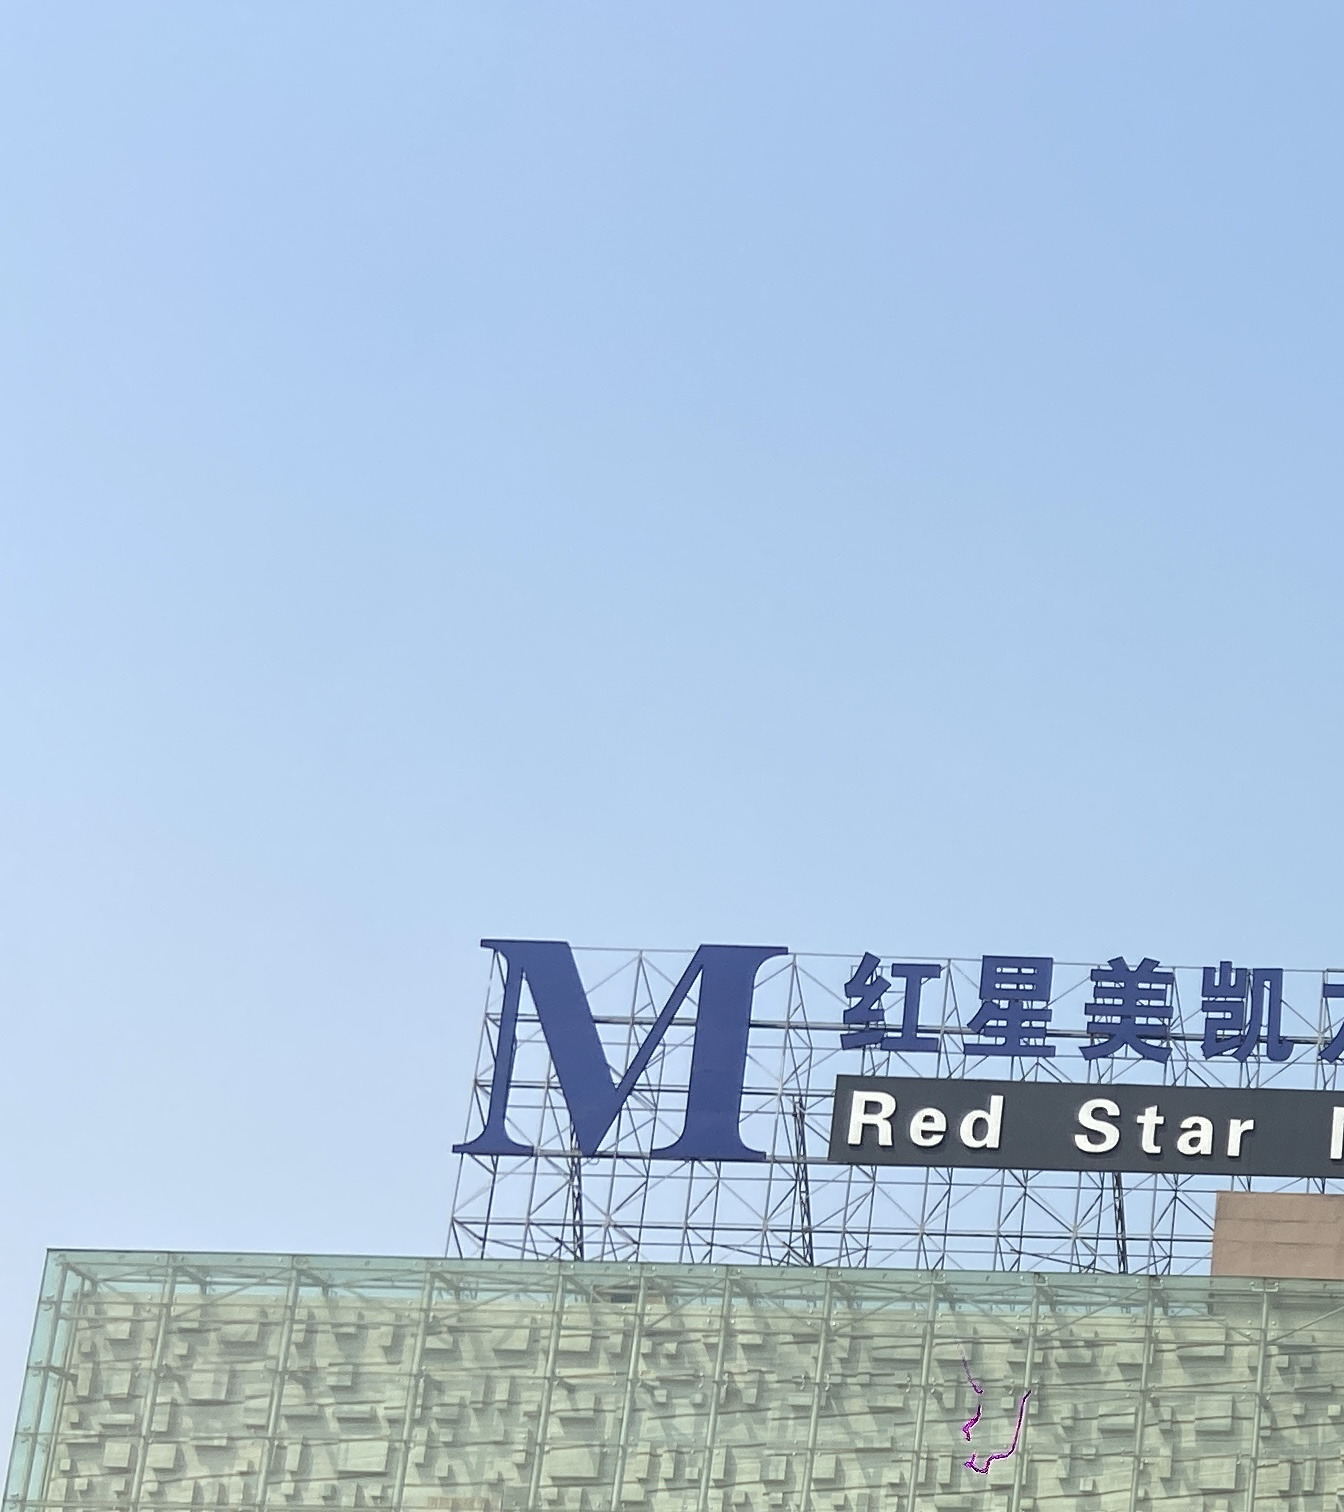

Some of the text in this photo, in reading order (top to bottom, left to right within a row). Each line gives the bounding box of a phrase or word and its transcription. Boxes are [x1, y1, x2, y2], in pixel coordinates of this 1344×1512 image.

[452, 938, 788, 1161] M
[846, 1090, 1005, 1150] Red
[1073, 1097, 1256, 1158] Star
